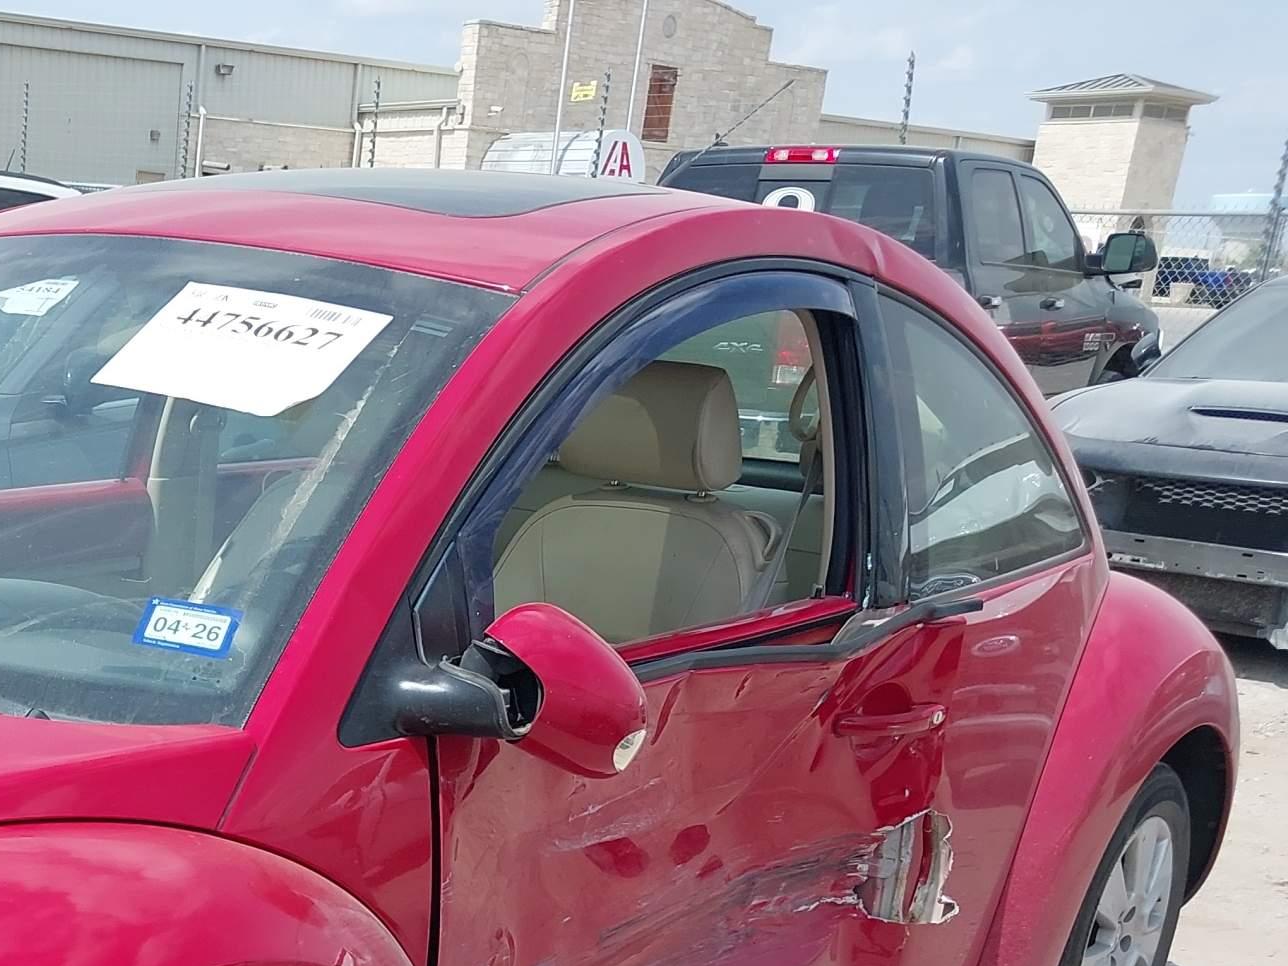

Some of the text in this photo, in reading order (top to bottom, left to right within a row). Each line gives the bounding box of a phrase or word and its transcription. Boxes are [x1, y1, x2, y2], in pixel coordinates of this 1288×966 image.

[176, 307, 344, 351] 44756627
[153, 616, 181, 635] 04
[191, 623, 222, 642] 26
